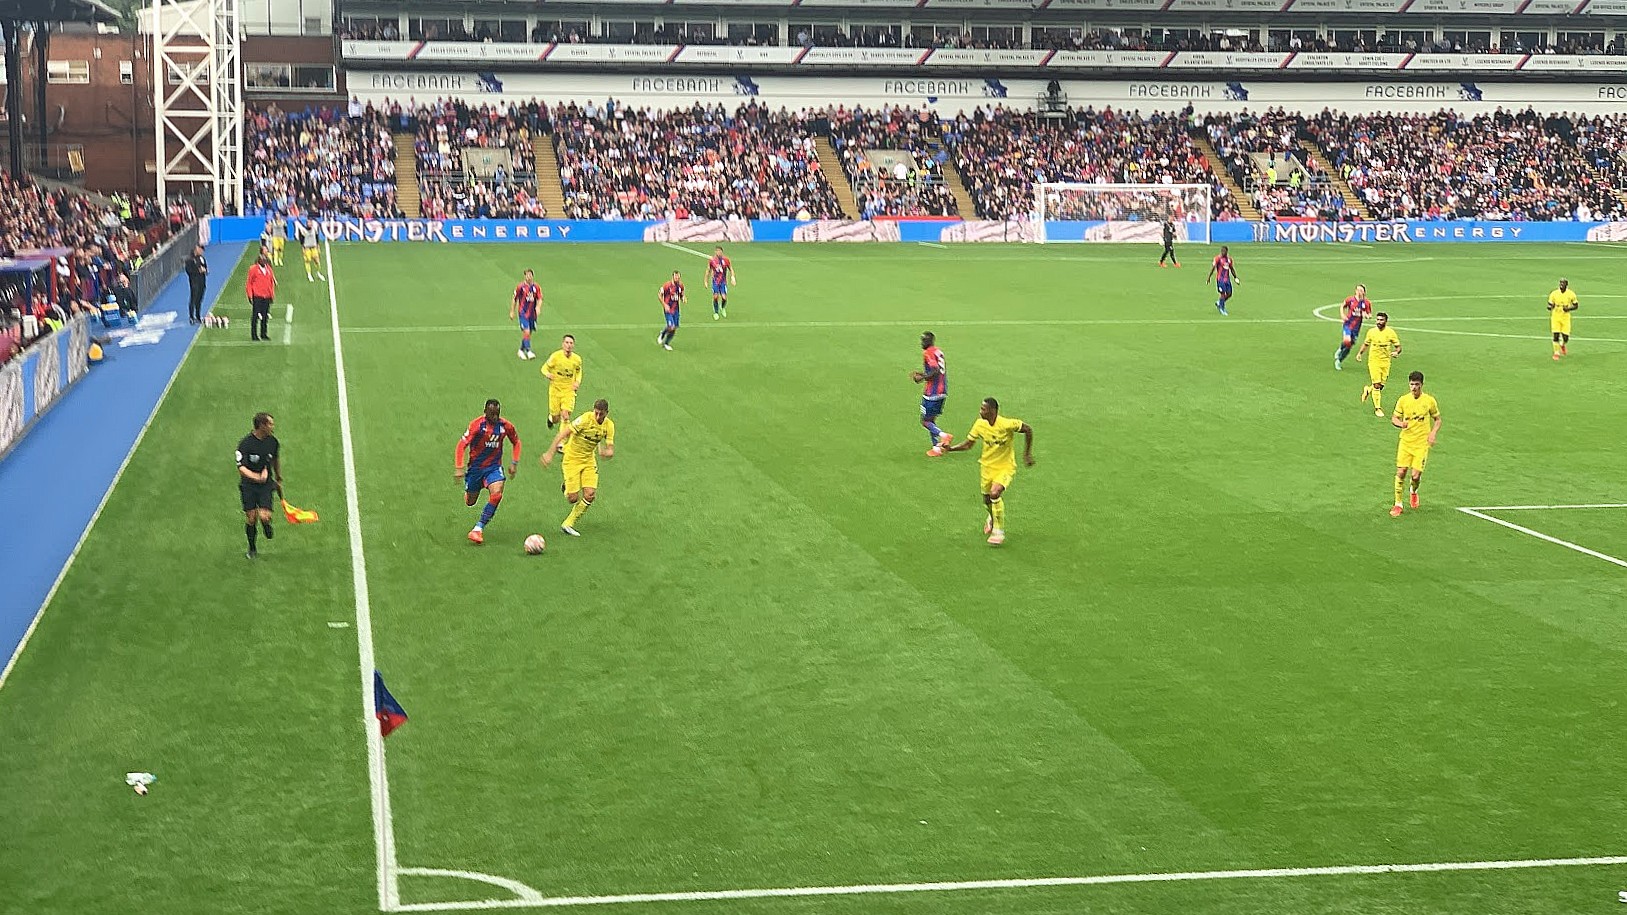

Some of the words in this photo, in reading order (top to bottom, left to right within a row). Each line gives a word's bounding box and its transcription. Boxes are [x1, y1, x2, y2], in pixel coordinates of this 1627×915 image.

[372, 73, 462, 90] FACEBANK
[632, 77, 719, 92] FACEBANK
[884, 80, 968, 95] FACEBANK
[1129, 83, 1211, 98] FACEBANK
[1365, 85, 1445, 98] FACEBANK
[451, 225, 571, 238] ENERGY
[1275, 221, 1412, 242] MONSTER
[1415, 227, 1522, 238] ENERGY
